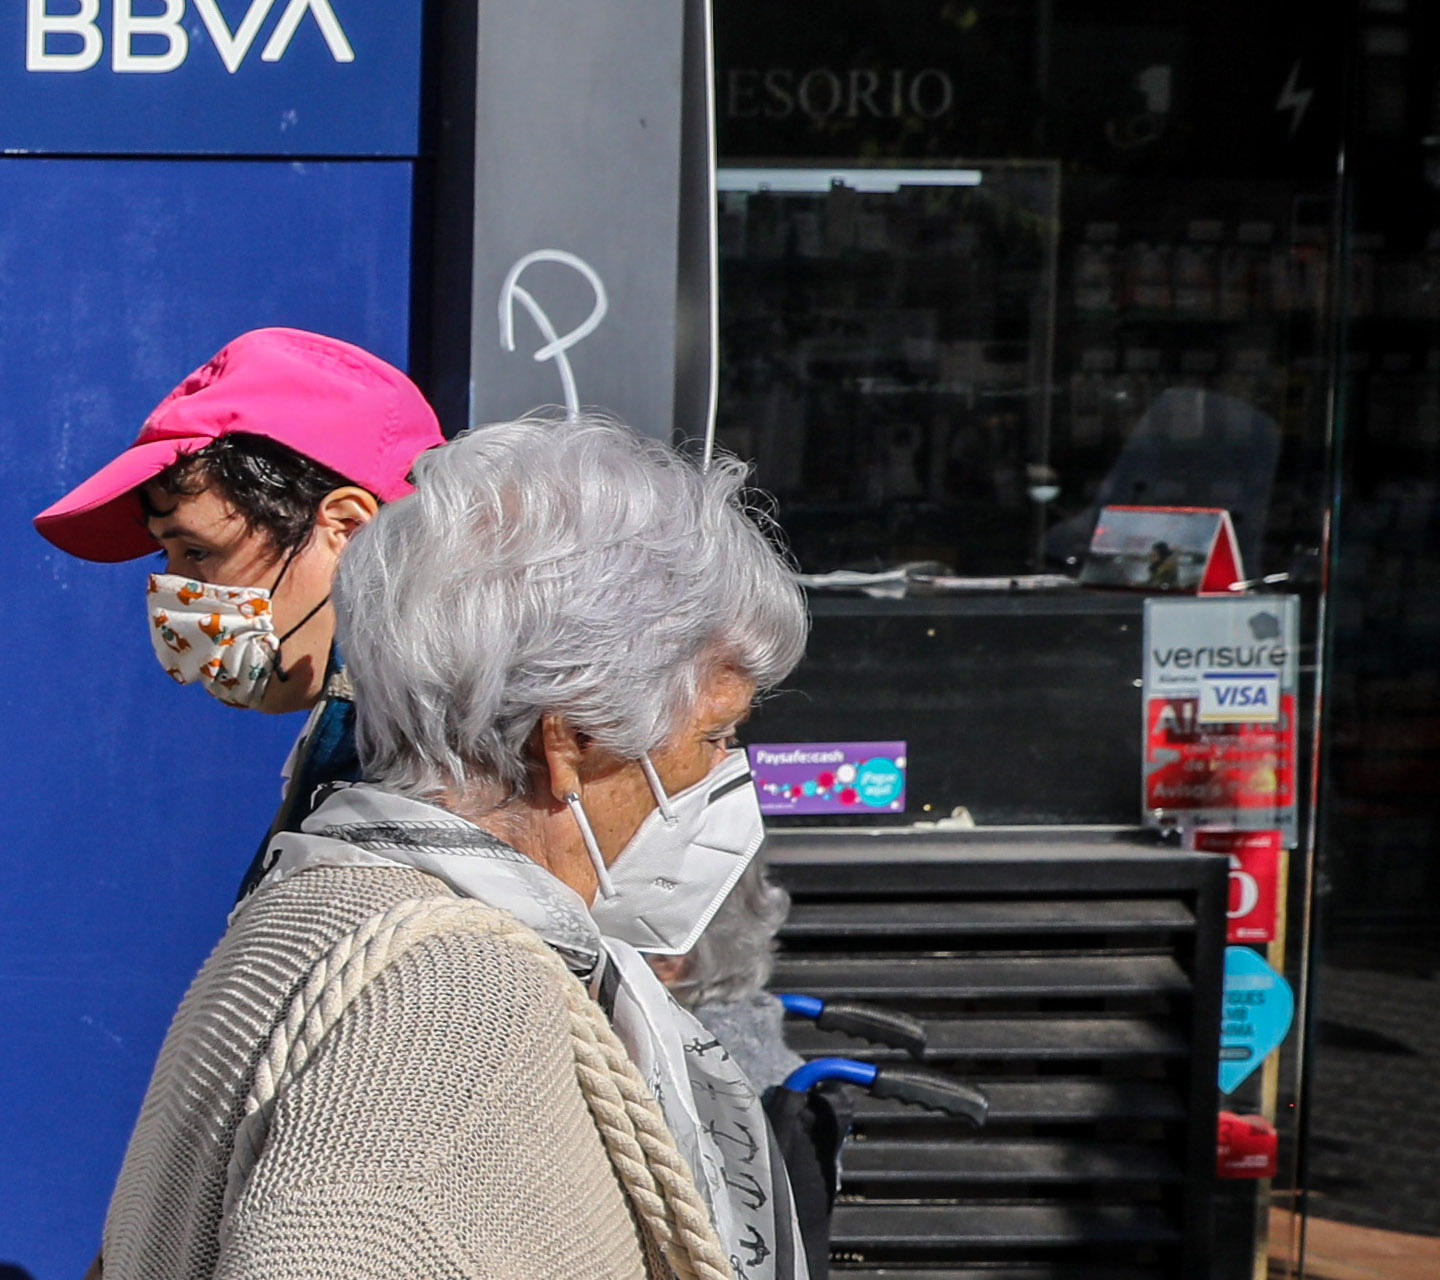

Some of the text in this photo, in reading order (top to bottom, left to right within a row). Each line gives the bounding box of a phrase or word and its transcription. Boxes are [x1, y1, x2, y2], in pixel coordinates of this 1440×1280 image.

[723, 66, 955, 119] ESORIO
[1152, 644, 1289, 668] verisure
[1214, 685, 1268, 707] VISA
